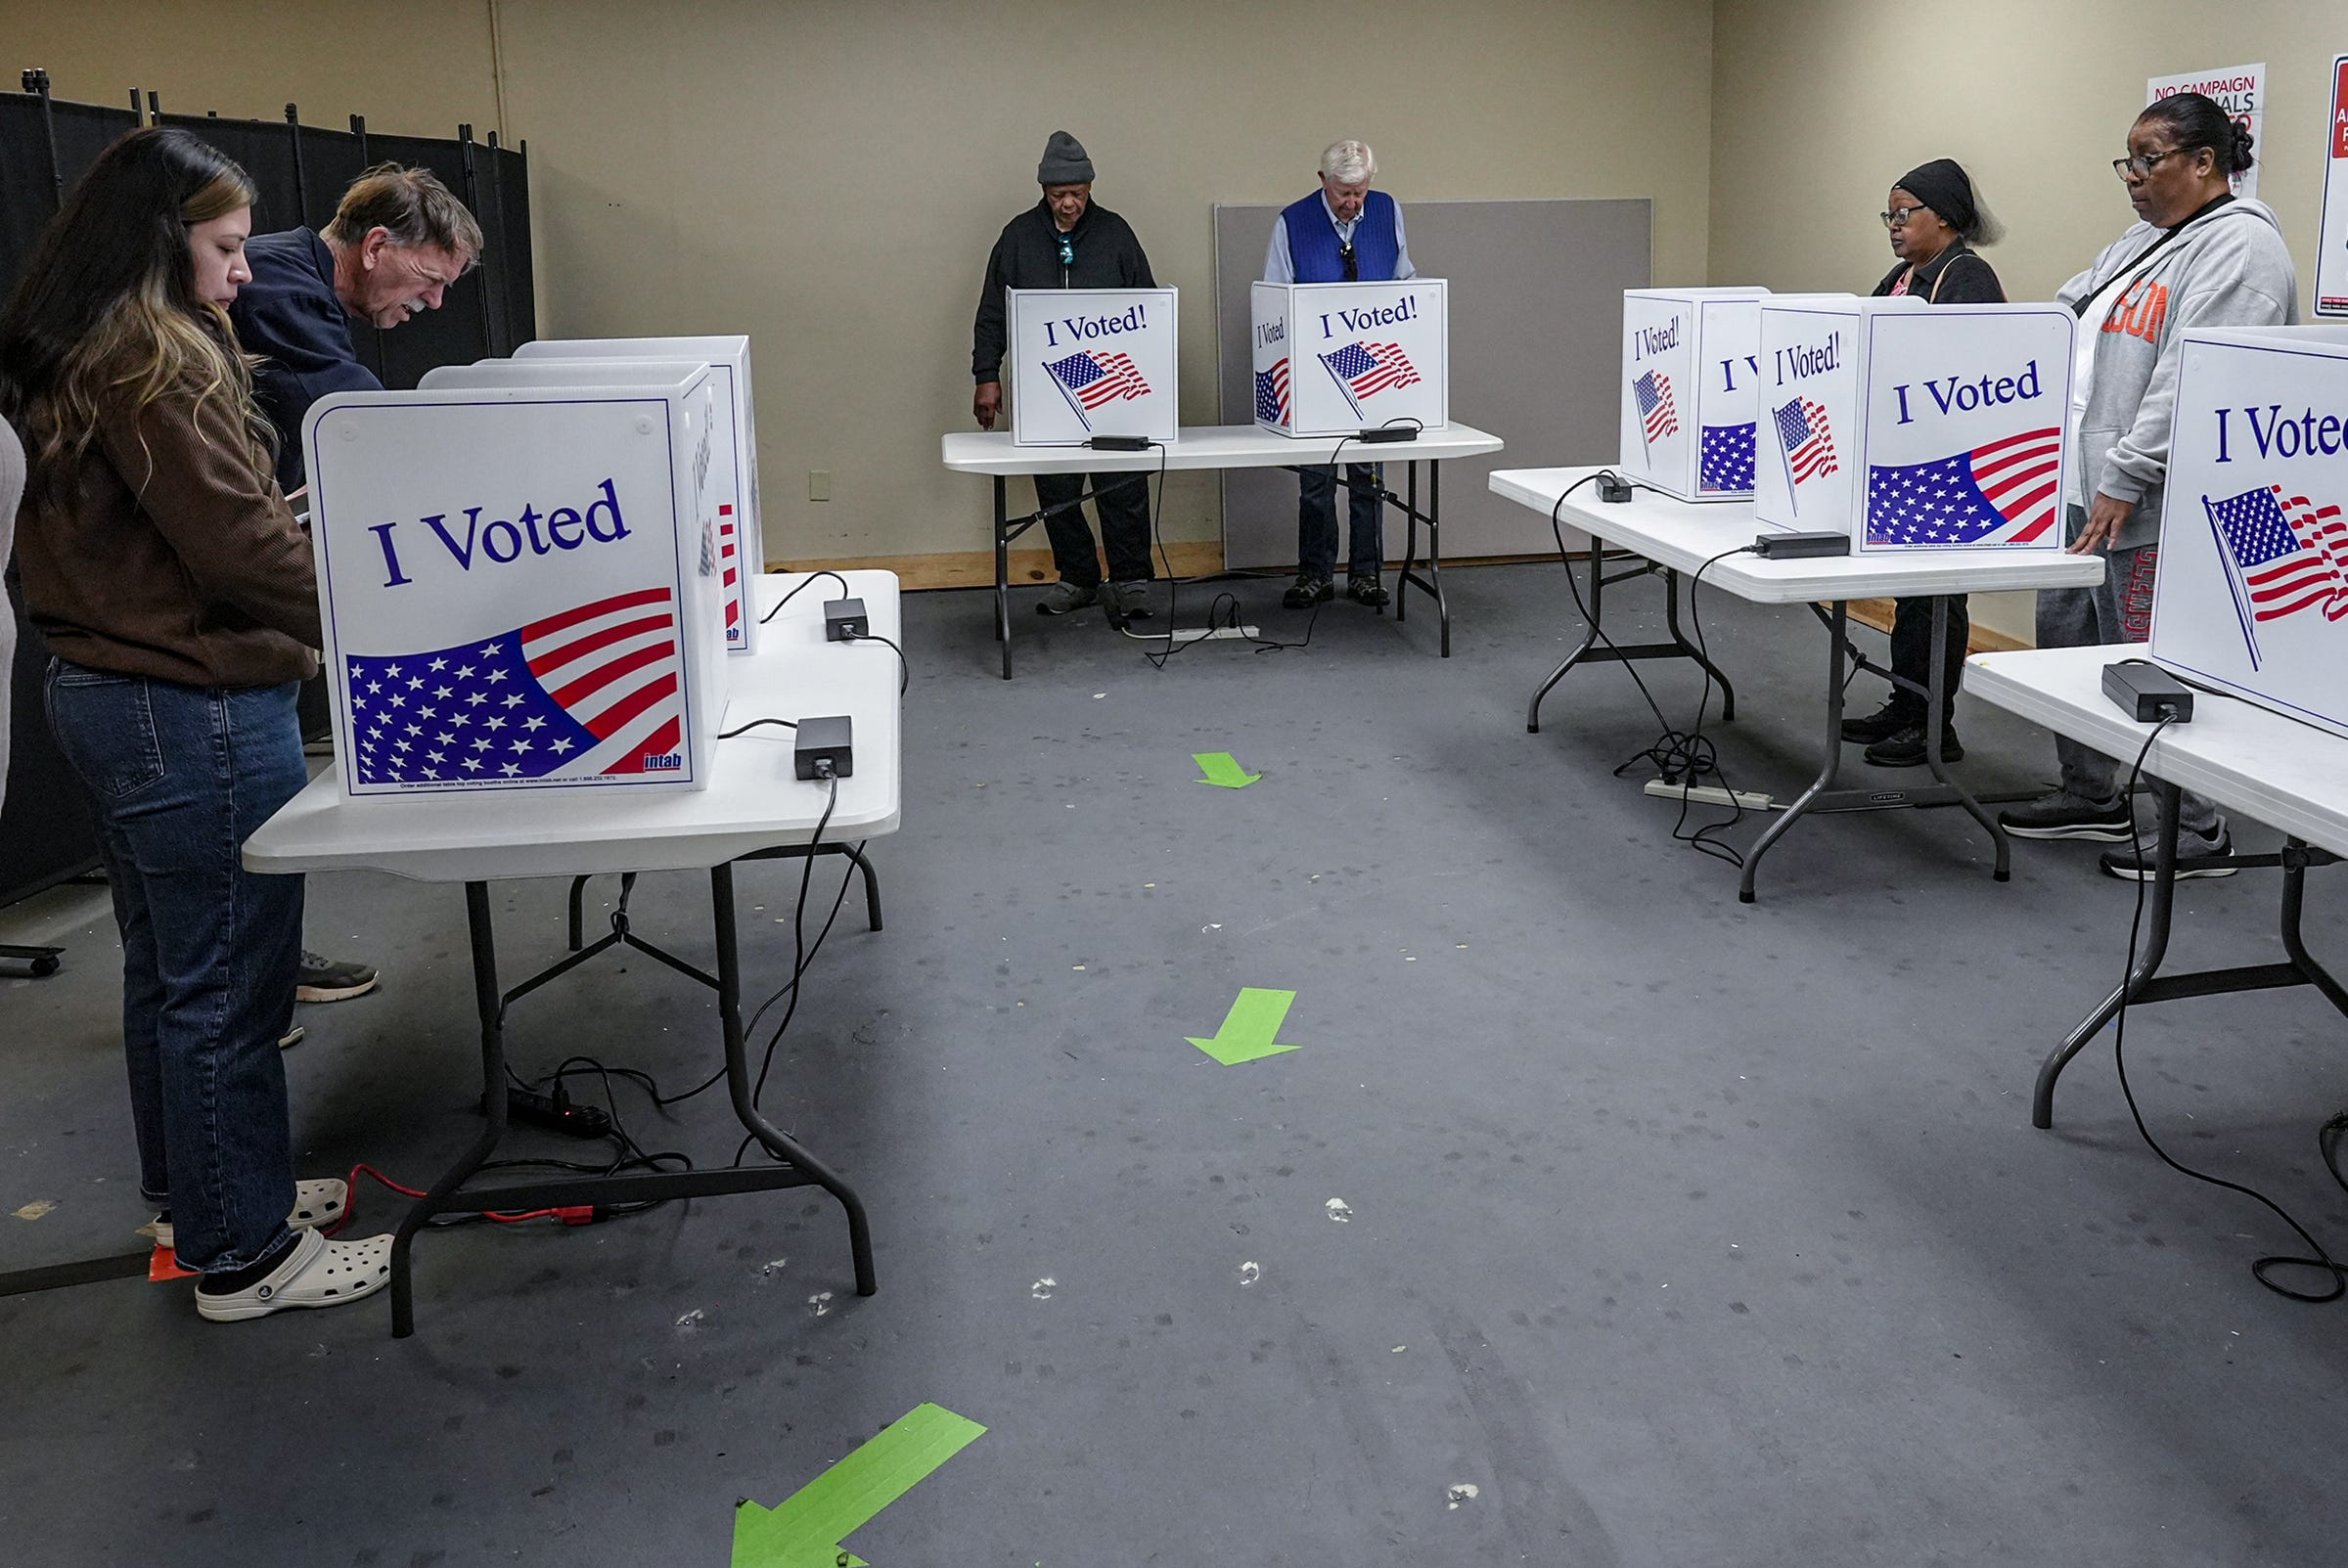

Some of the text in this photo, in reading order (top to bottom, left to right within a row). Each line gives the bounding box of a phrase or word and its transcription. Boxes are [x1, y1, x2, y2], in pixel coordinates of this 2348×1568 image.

[2155, 76, 2255, 101] NO CAMPAIGN
[1044, 303, 1147, 347] I Voted!
[1320, 294, 1418, 339] I Voted!
[1635, 315, 1680, 362] I Voted!
[1720, 359, 1738, 392] I
[1775, 349, 1784, 386] I
[1786, 331, 1840, 381] Voted!
[1893, 359, 2043, 425] I Voted
[2214, 404, 2348, 463] I Vote
[367, 477, 632, 588] I Voted
[644, 752, 682, 769] intab
